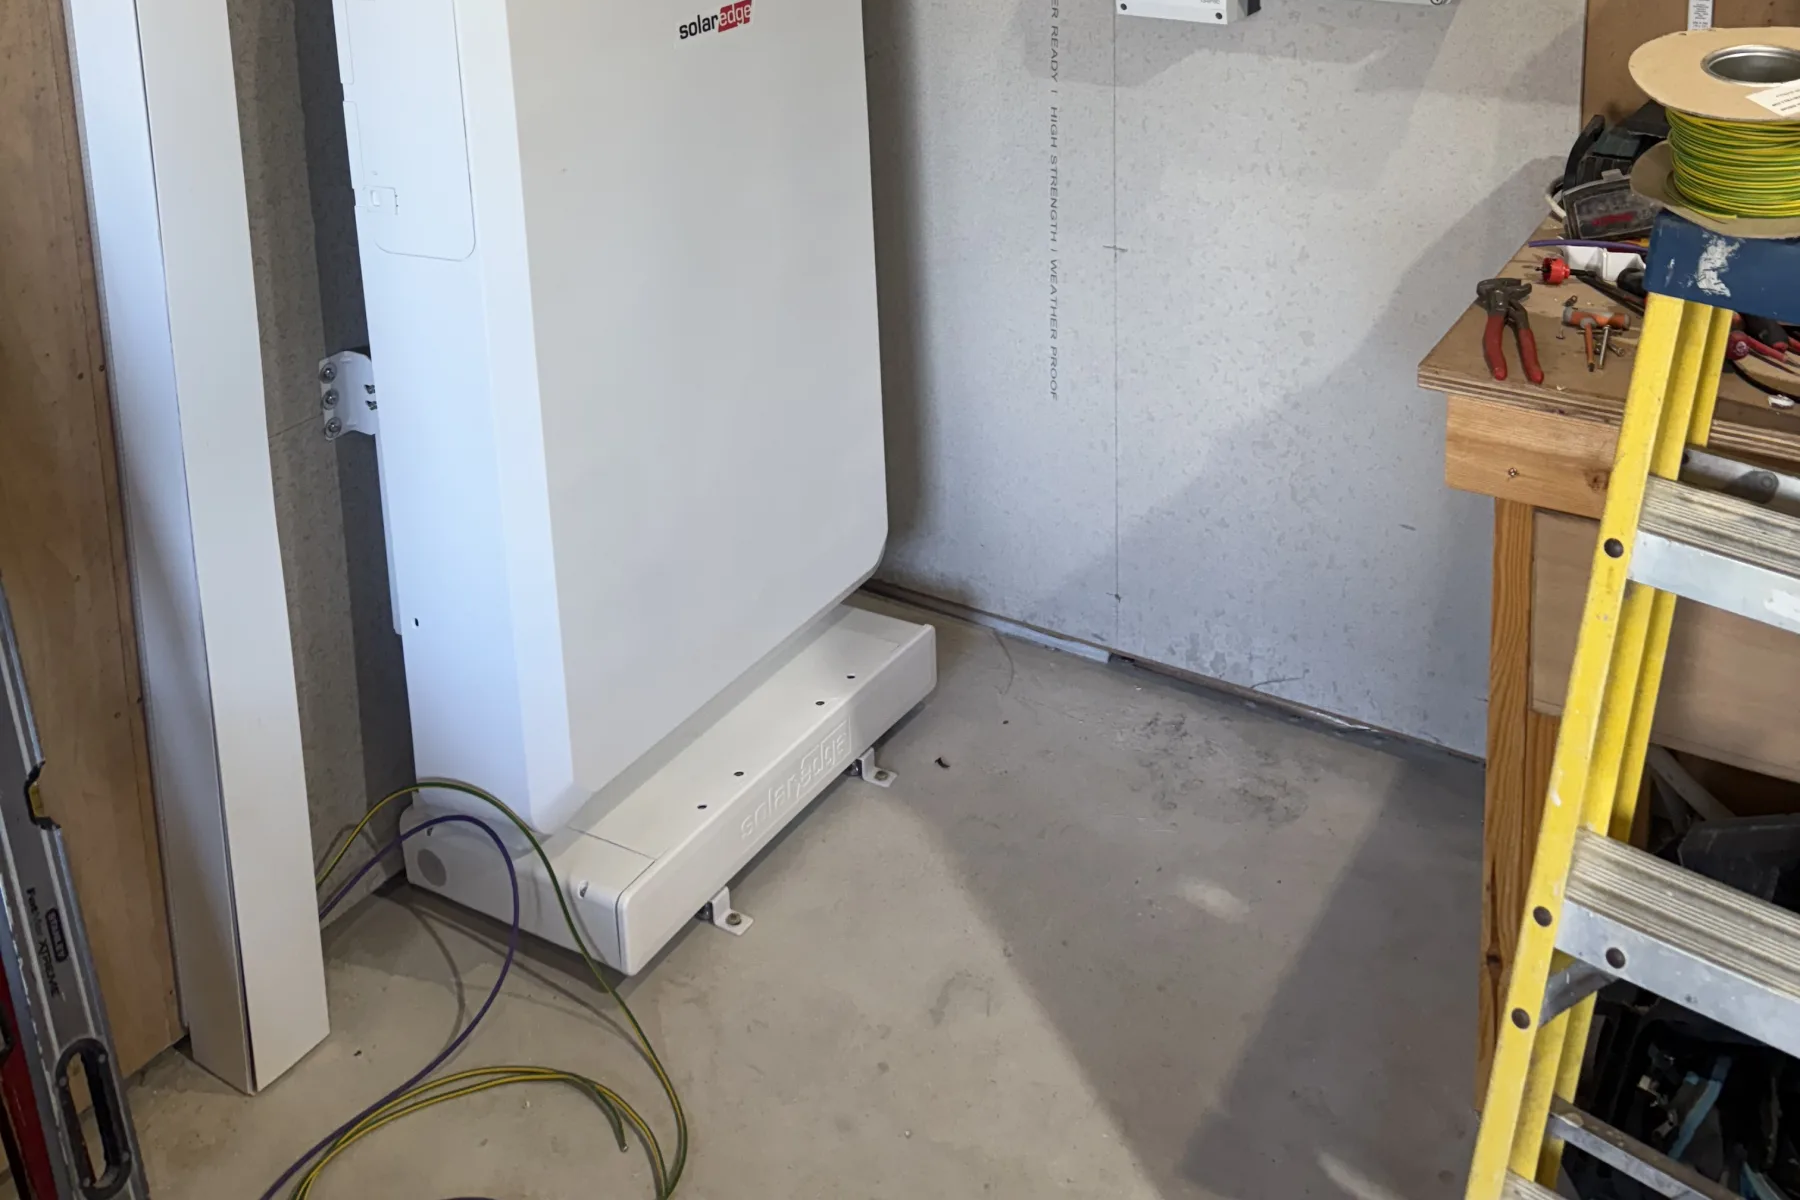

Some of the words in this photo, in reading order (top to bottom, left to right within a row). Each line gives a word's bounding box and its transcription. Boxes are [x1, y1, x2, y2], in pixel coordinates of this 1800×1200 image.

[1050, 25, 1060, 83] READY
[1049, 106, 1058, 148] HIGH
[1049, 155, 1059, 243] STRENGTH
[1049, 259, 1059, 340] WEATHER
[1049, 345, 1059, 402] PROOF
[741, 722, 851, 840] solaredge
